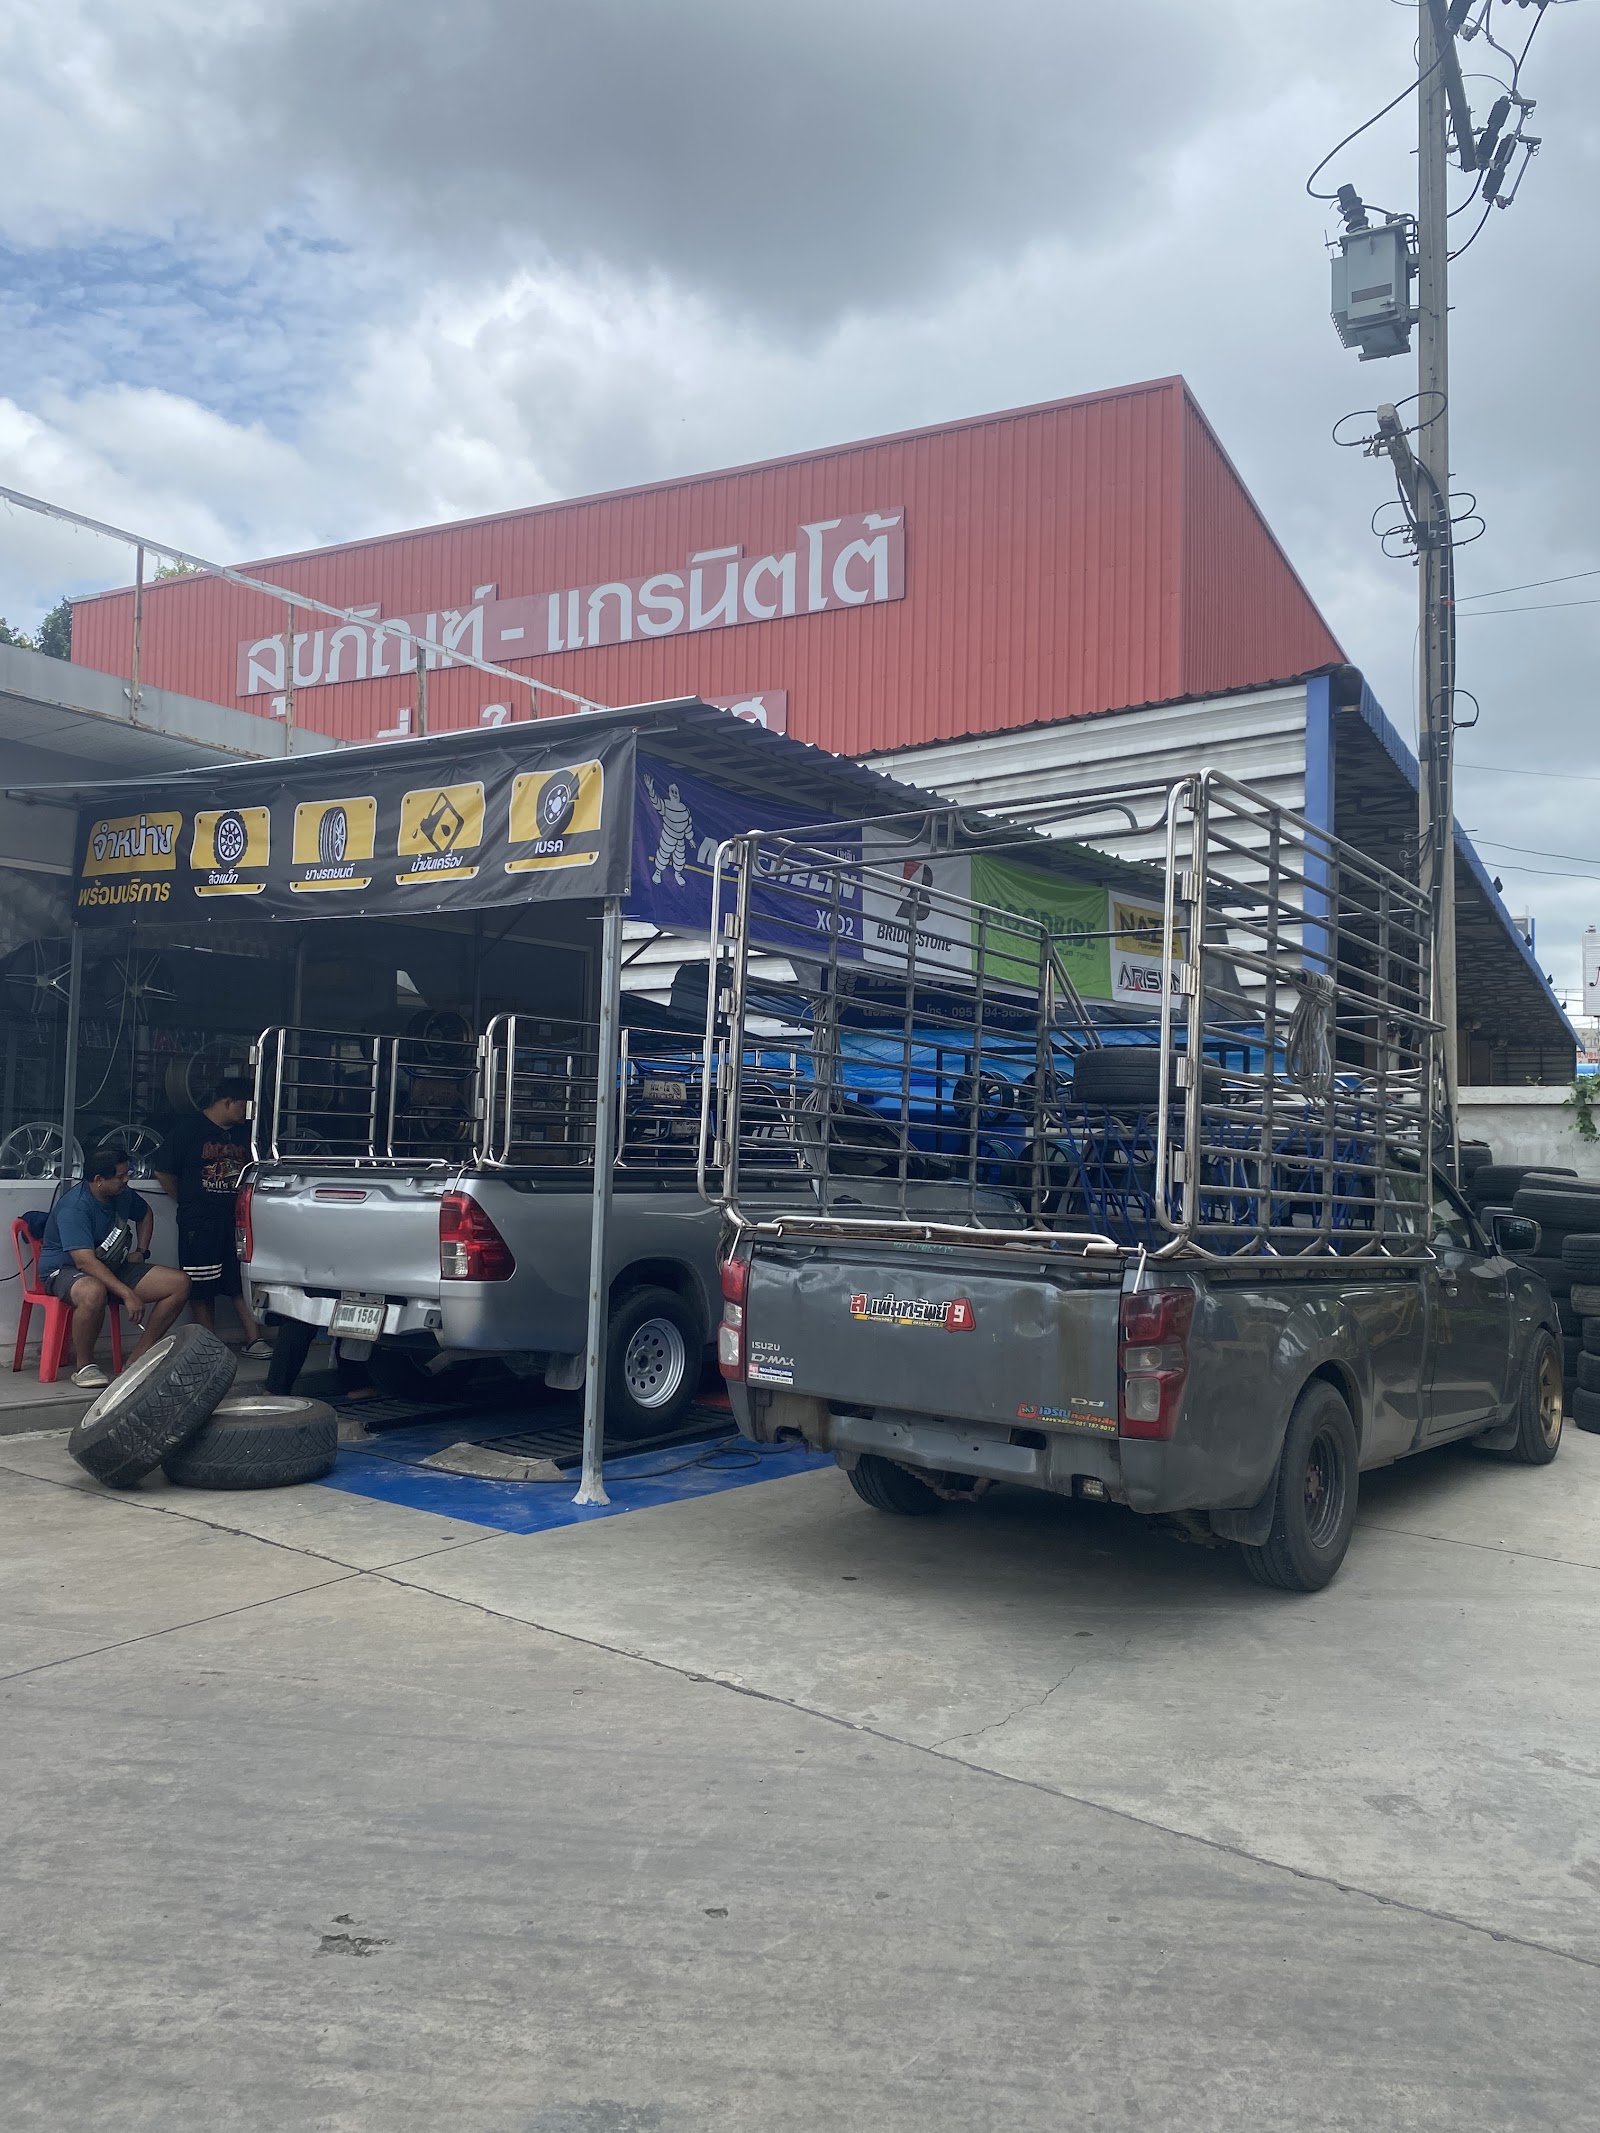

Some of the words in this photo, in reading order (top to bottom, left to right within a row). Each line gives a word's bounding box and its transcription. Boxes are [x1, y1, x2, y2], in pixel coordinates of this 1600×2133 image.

[547, 513, 901, 653] แกรนิตโต้
[93, 814, 174, 861] จำหน่าย
[534, 839, 564, 854] เบรค
[411, 848, 464, 873] น้ำมันเครื่อง
[208, 868, 239, 885] ล้อแม็ก
[304, 863, 356, 881] ยางรถยนต์
[78, 877, 171, 907] พร้อมบริการ
[100, 1226, 122, 1252] PUMA
[357, 1308, 381, 1325] 1584
[751, 1341, 781, 1352] ISUZU
